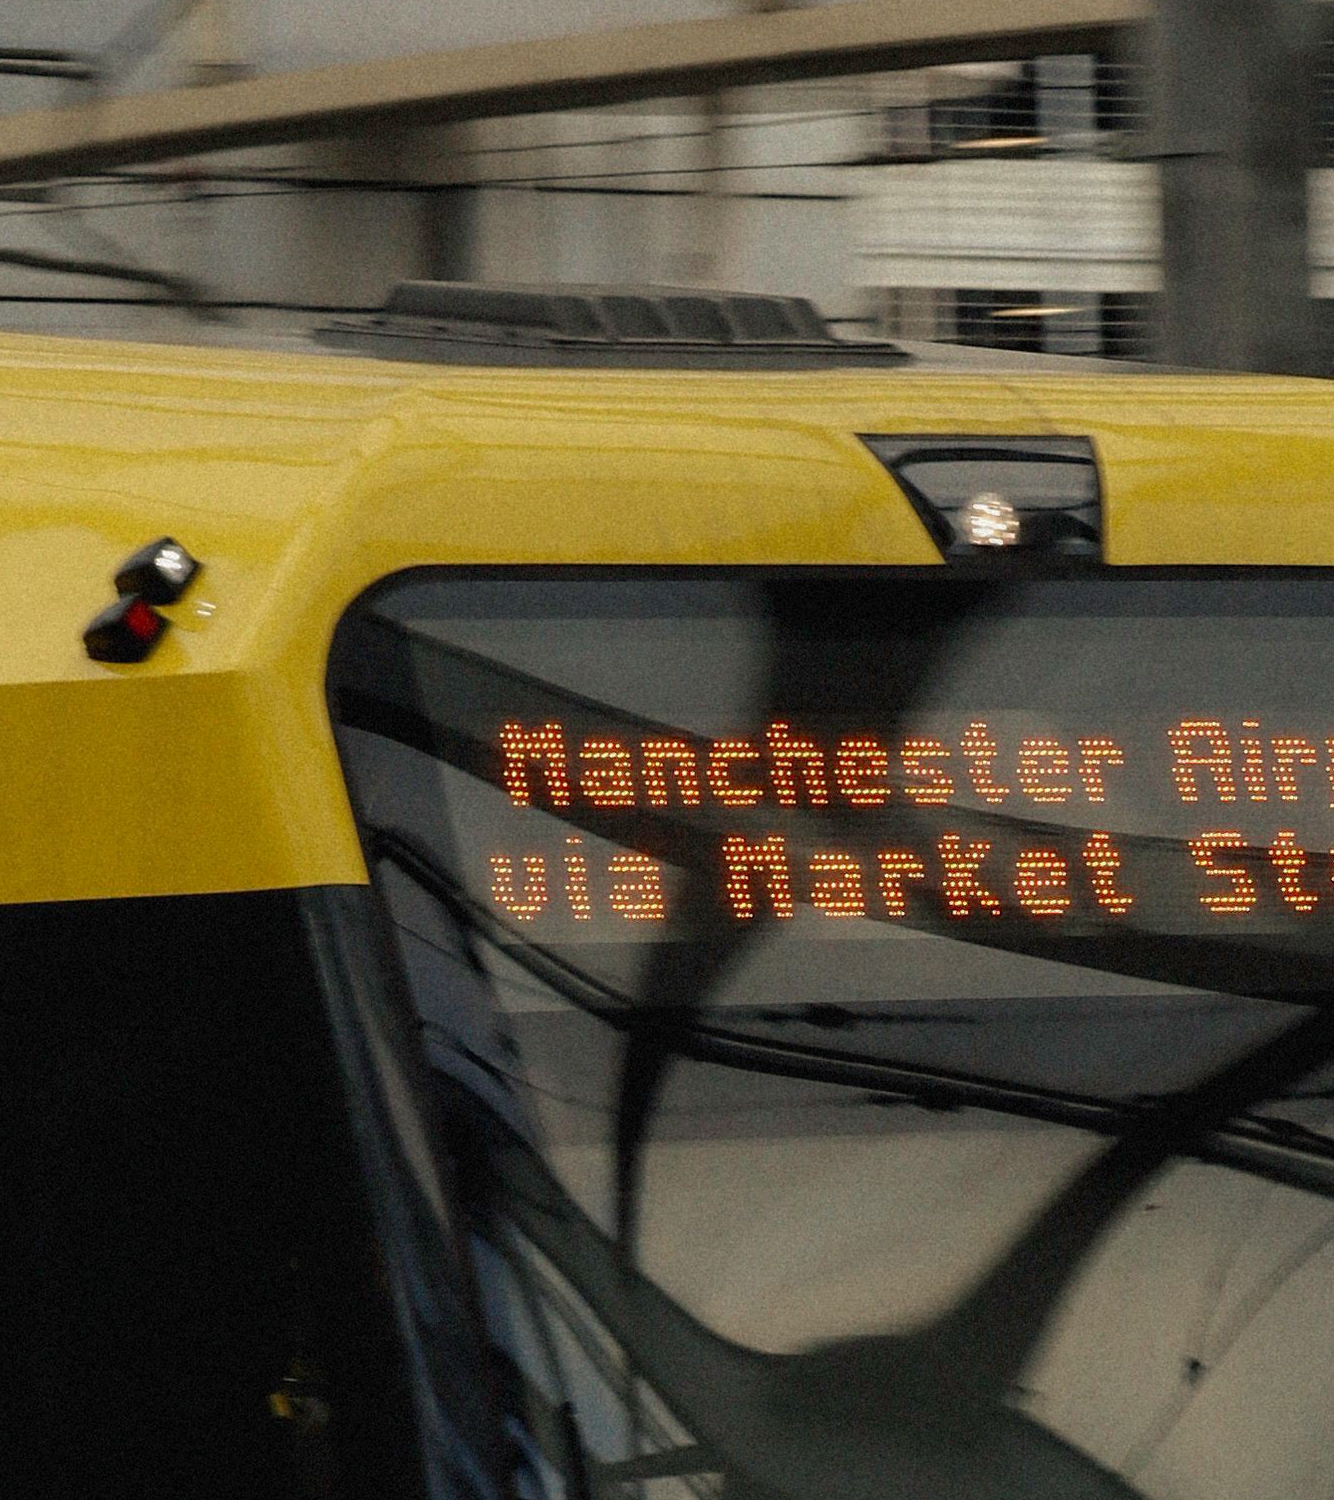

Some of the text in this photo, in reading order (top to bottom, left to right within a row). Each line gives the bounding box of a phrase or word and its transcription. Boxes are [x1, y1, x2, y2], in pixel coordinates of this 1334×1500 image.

[499, 718, 1124, 809] Manchester
[489, 835, 667, 922] via
[721, 828, 1136, 920] Market
